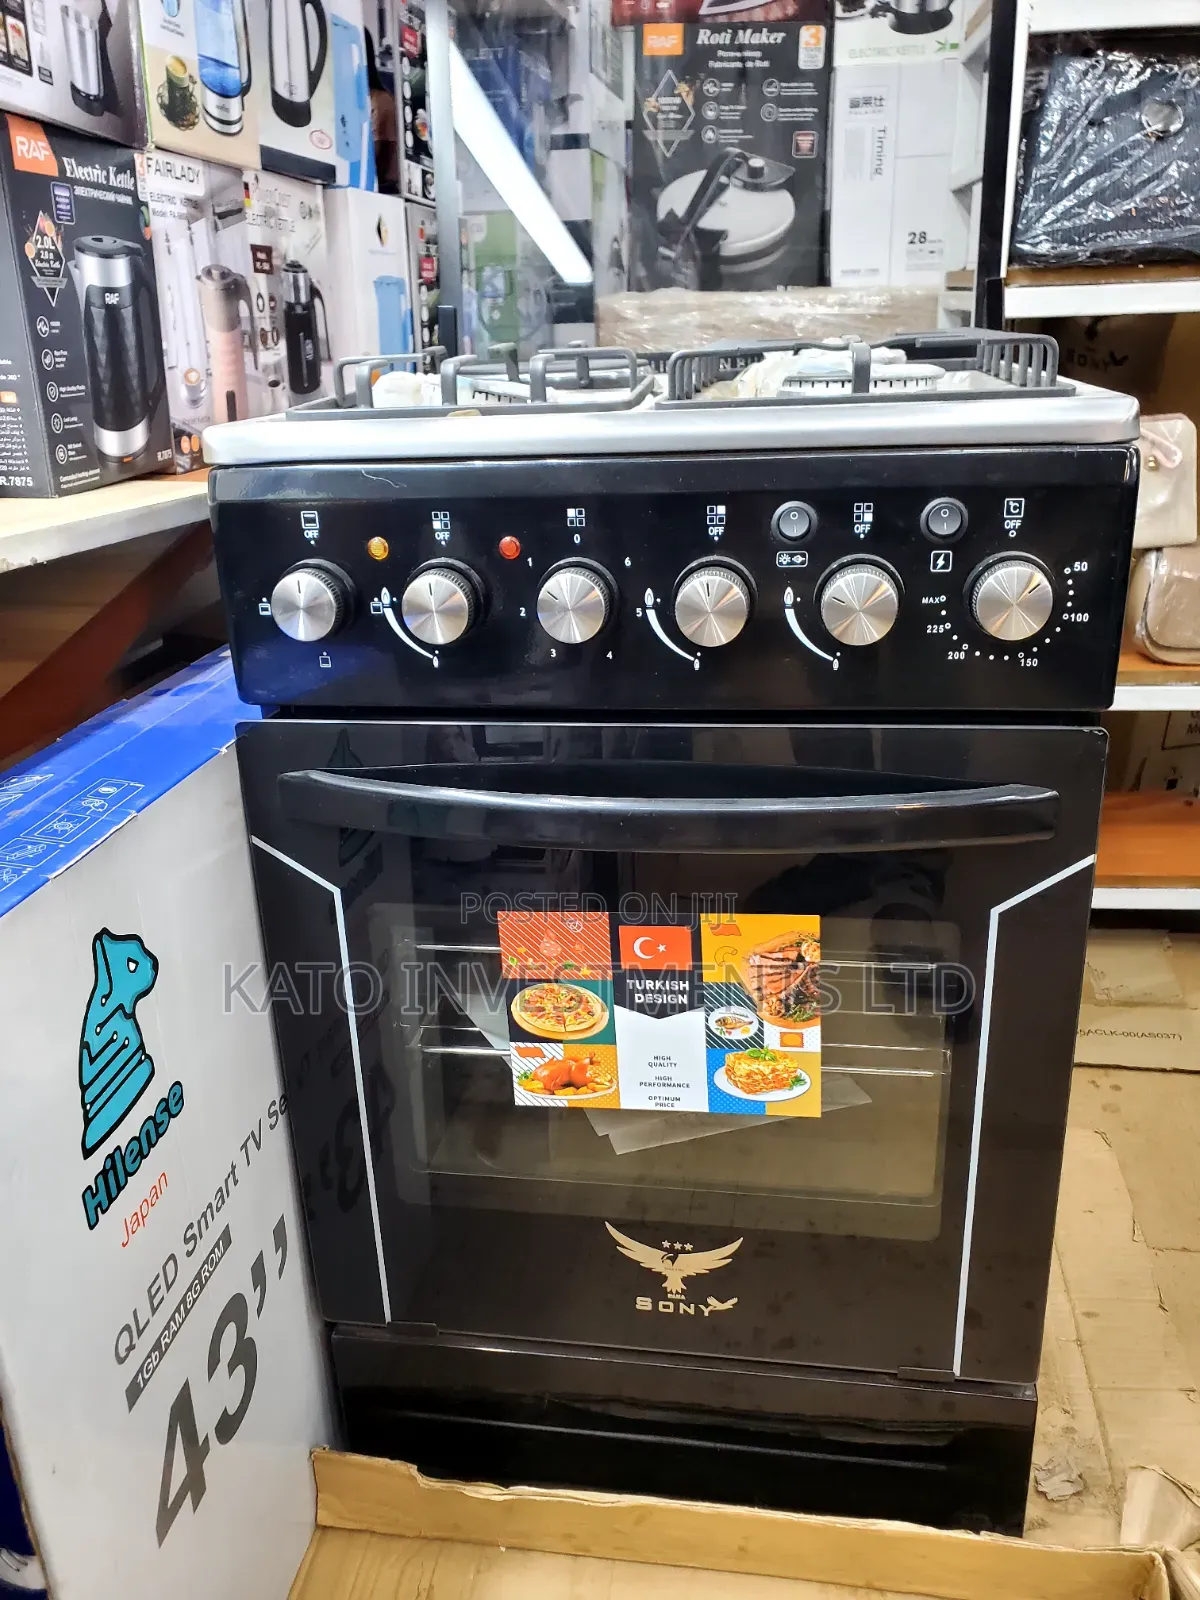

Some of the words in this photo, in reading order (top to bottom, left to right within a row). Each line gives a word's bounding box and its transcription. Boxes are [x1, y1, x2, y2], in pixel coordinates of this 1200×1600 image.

[647, 35, 680, 48] RAF
[696, 28, 732, 45] Roti
[735, 28, 787, 45] Maker
[16, 136, 50, 161] RAF
[875, 125, 888, 177] Timing
[62, 156, 107, 184] Electric
[109, 165, 135, 191] Kettle
[146, 157, 201, 184] FAIRLADY
[35, 235, 56, 250] 2.0L
[907, 231, 928, 245] 28
[105, 292, 120, 306] RAF
[0, 475, 34, 488] R.7875
[854, 523, 871, 534] OFF
[1004, 519, 1021, 529] OFF
[303, 529, 319, 539] OFF
[434, 531, 450, 541] OFF
[708, 526, 724, 536] OFF
[527, 557, 533, 567] 1
[624, 557, 632, 567] 6
[1074, 561, 1088, 572] 50
[922, 596, 940, 604] MAX
[519, 607, 526, 617] 2
[636, 607, 643, 617] 5
[1070, 612, 1090, 623] 100
[926, 624, 945, 634] 225
[550, 648, 557, 658] 3
[606, 650, 613, 660] 4
[947, 650, 966, 661] 200
[1020, 657, 1039, 668] 150
[626, 978, 690, 992] TURKISH
[634, 992, 689, 1005] DESIGN
[647, 1061, 678, 1069] QUALITY
[639, 1081, 691, 1089] PERFORMANCE
[81, 1080, 185, 1231] Hilense
[121, 1171, 169, 1249] Japan
[113, 1251, 179, 1367] QLED
[183, 1162, 240, 1259] Smart
[240, 1118, 263, 1167] TV
[635, 1296, 715, 1317] SONY
[136, 1348, 160, 1391] 1Gb
[159, 1309, 187, 1354] RAM
[186, 1282, 202, 1310] 8G
[200, 1240, 226, 1286] ROM
